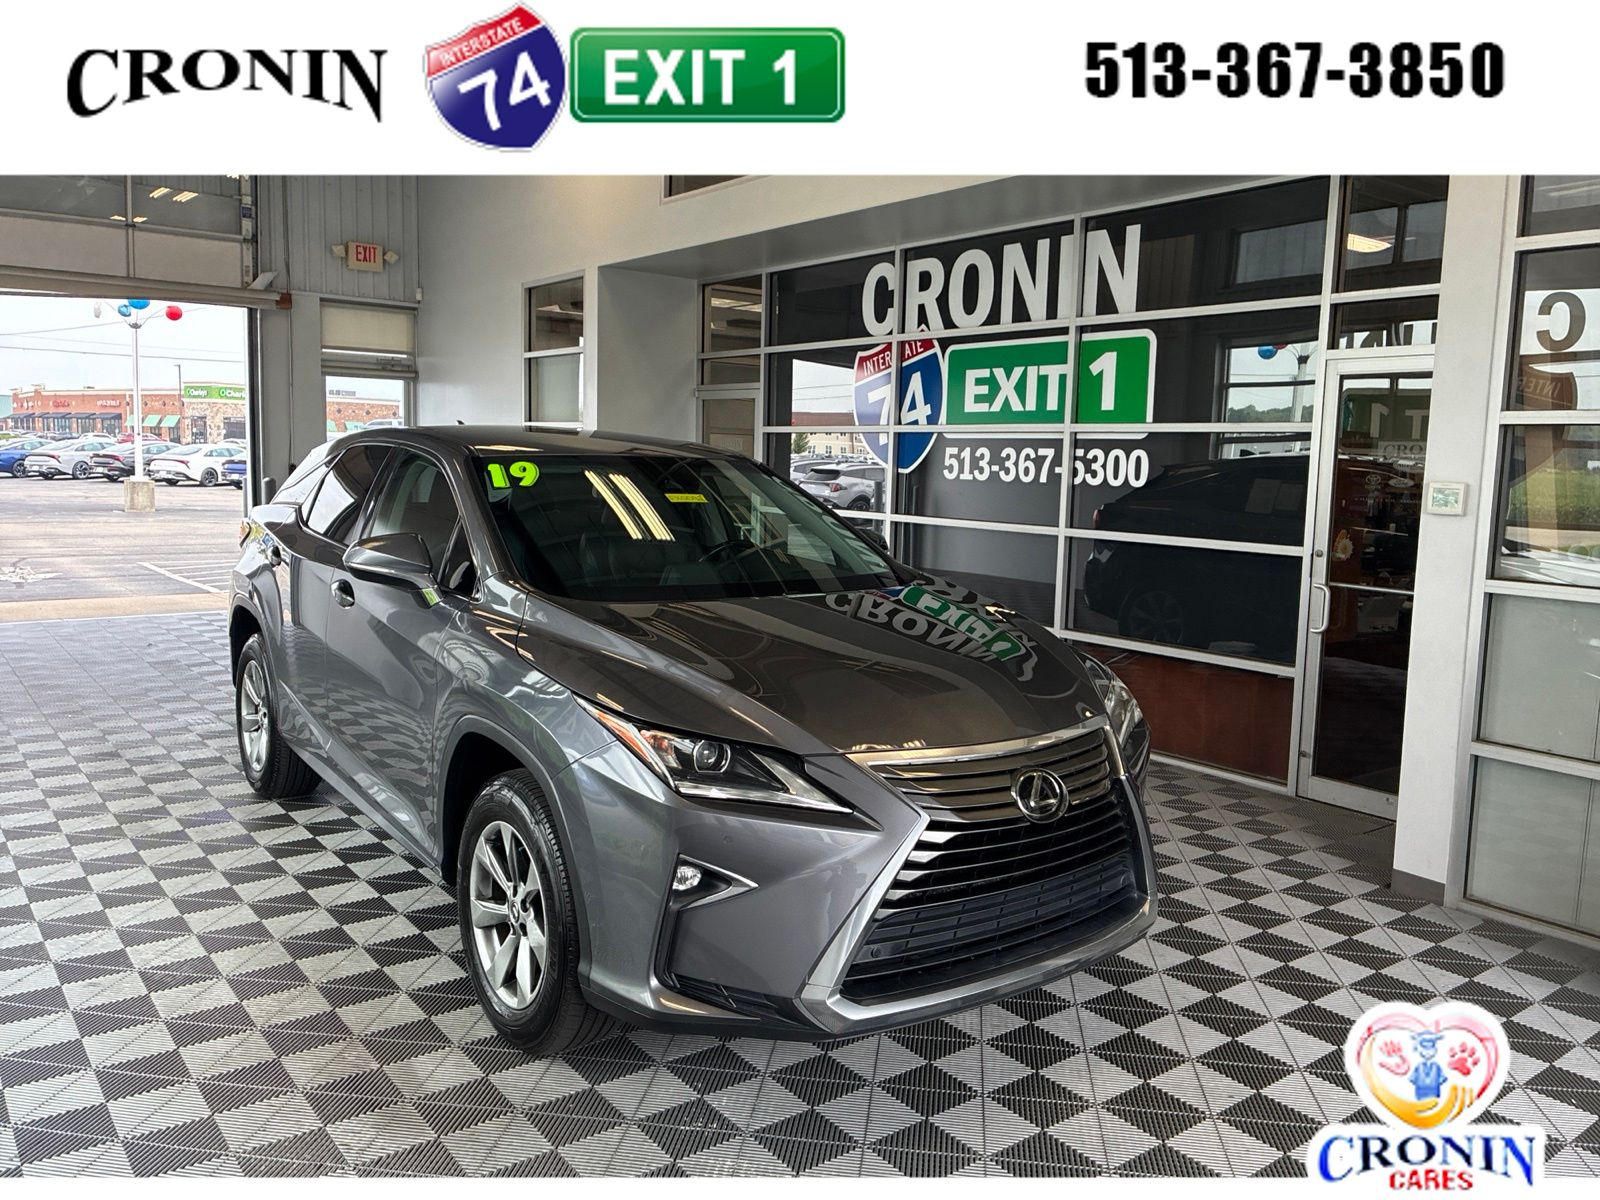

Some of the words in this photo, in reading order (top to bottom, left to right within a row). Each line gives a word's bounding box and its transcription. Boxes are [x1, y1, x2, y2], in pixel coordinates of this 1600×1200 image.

[355, 245, 377, 263] EXIT
[862, 224, 1141, 336] CRONIN
[863, 339, 924, 376] INTERATE
[964, 364, 1068, 413] EXIT
[1088, 351, 1118, 411] 1
[867, 370, 932, 447] 74
[487, 461, 540, 488] 19
[943, 446, 1149, 488] 513-367-5300
